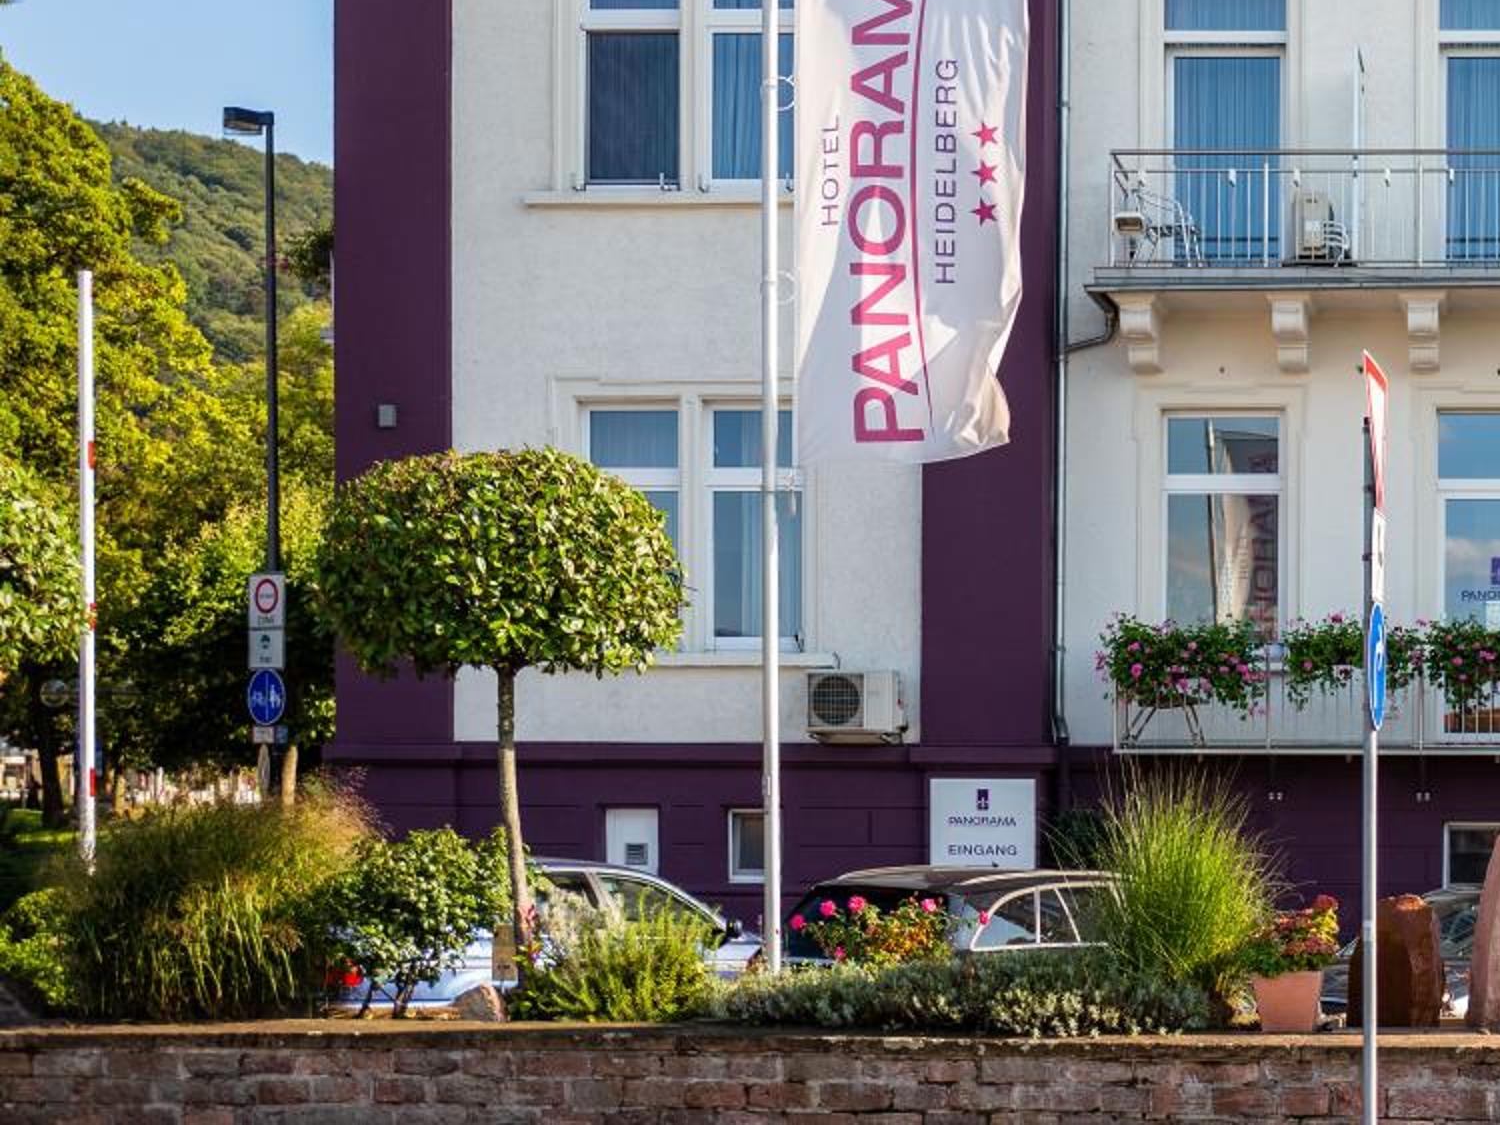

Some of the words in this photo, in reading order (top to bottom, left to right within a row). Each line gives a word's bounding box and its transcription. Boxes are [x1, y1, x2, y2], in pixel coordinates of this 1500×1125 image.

[821, 116, 841, 227] HOTEL
[934, 58, 959, 284] HEIDELBERG
[947, 844, 1017, 856] EINGANG
[948, 816, 1017, 827] PANORAMA
